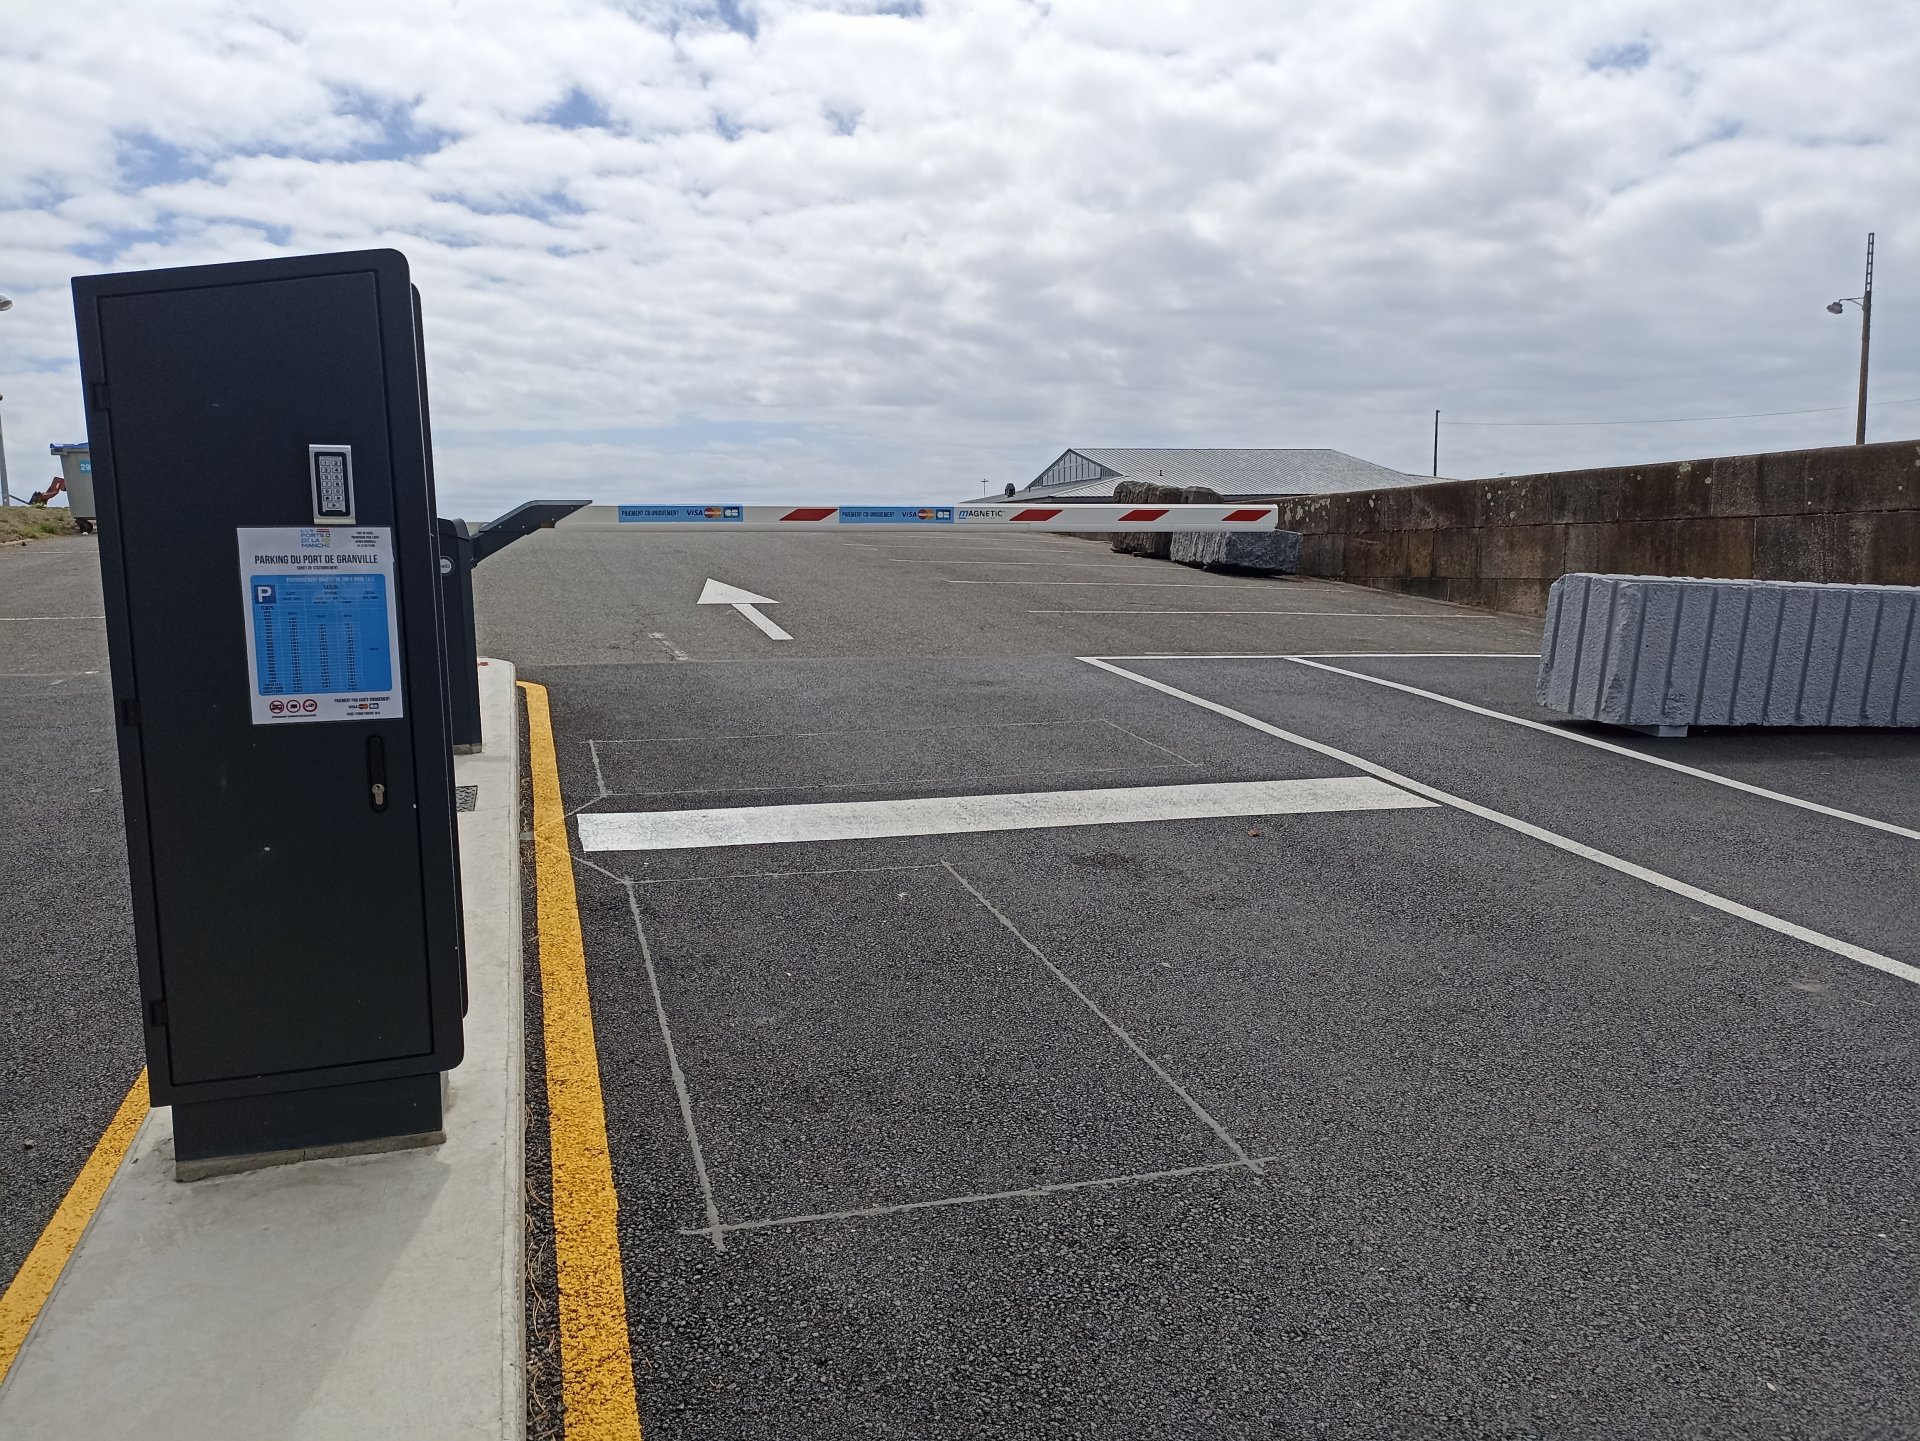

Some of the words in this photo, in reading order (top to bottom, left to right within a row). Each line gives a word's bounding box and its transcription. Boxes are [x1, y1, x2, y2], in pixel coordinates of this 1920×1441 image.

[254, 554, 289, 565] PARKING
[290, 555, 301, 565] DU
[303, 555, 322, 564] PORT
[325, 555, 335, 564] DE
[336, 554, 379, 564] GRANVILLE
[257, 586, 272, 603] P
